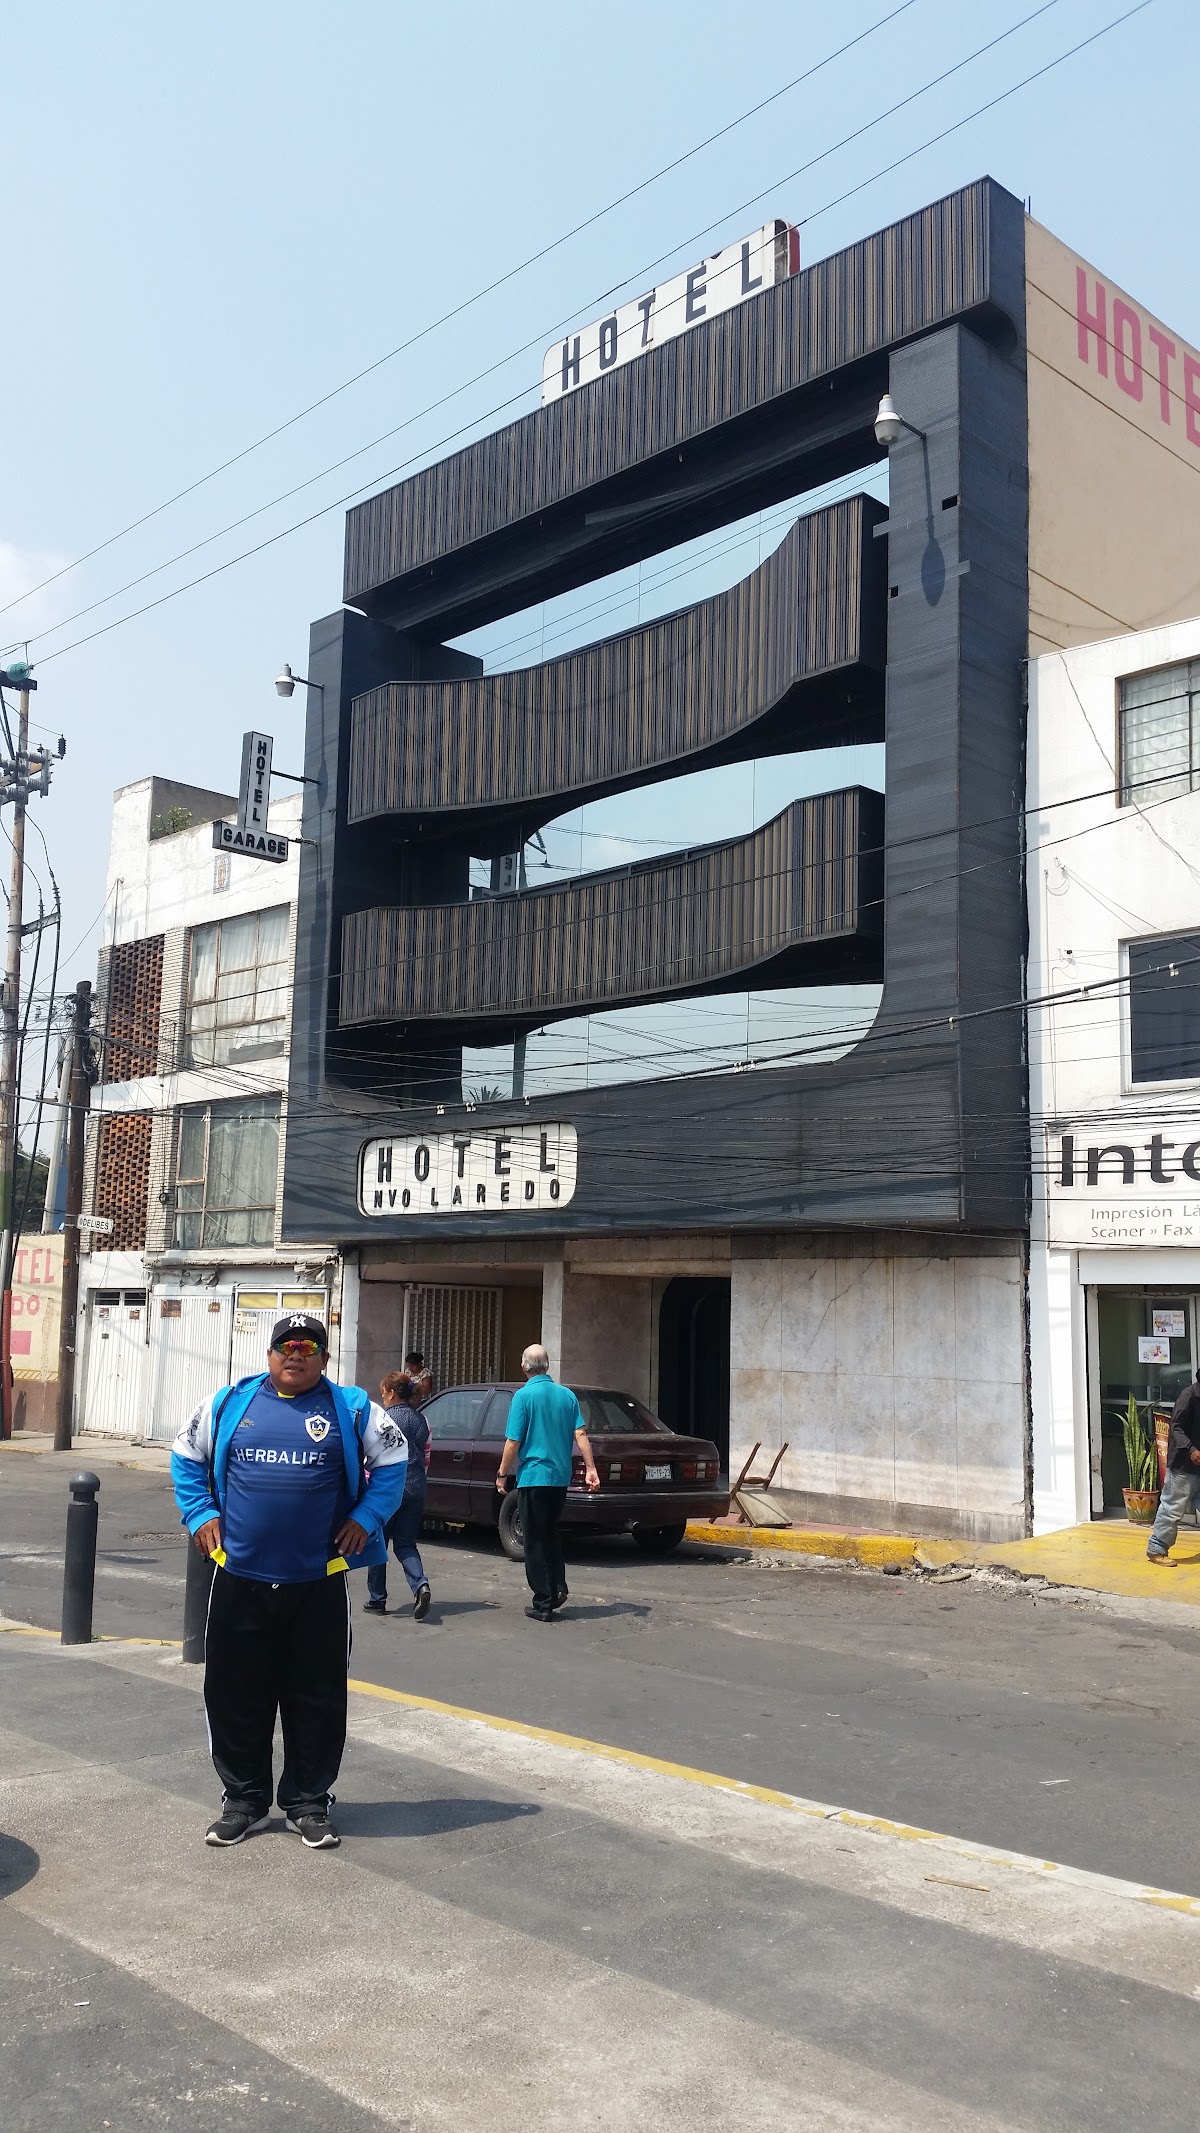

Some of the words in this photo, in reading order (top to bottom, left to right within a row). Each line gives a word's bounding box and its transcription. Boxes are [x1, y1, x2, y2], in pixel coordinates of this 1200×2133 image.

[562, 241, 763, 392] HOTEL
[252, 740, 267, 822] HOTEL
[223, 828, 286, 855] GARAGE
[377, 1132, 555, 1183] HOTEL
[373, 1188, 411, 1208] NVO
[430, 1178, 561, 1207] LAREDO
[1091, 1206, 1172, 1222] Impresión
[1091, 1226, 1145, 1238] Scaner
[1163, 1224, 1193, 1236] Fax
[312, 1423, 323, 1431] LA
[235, 1448, 327, 1466] HERBALIFE
